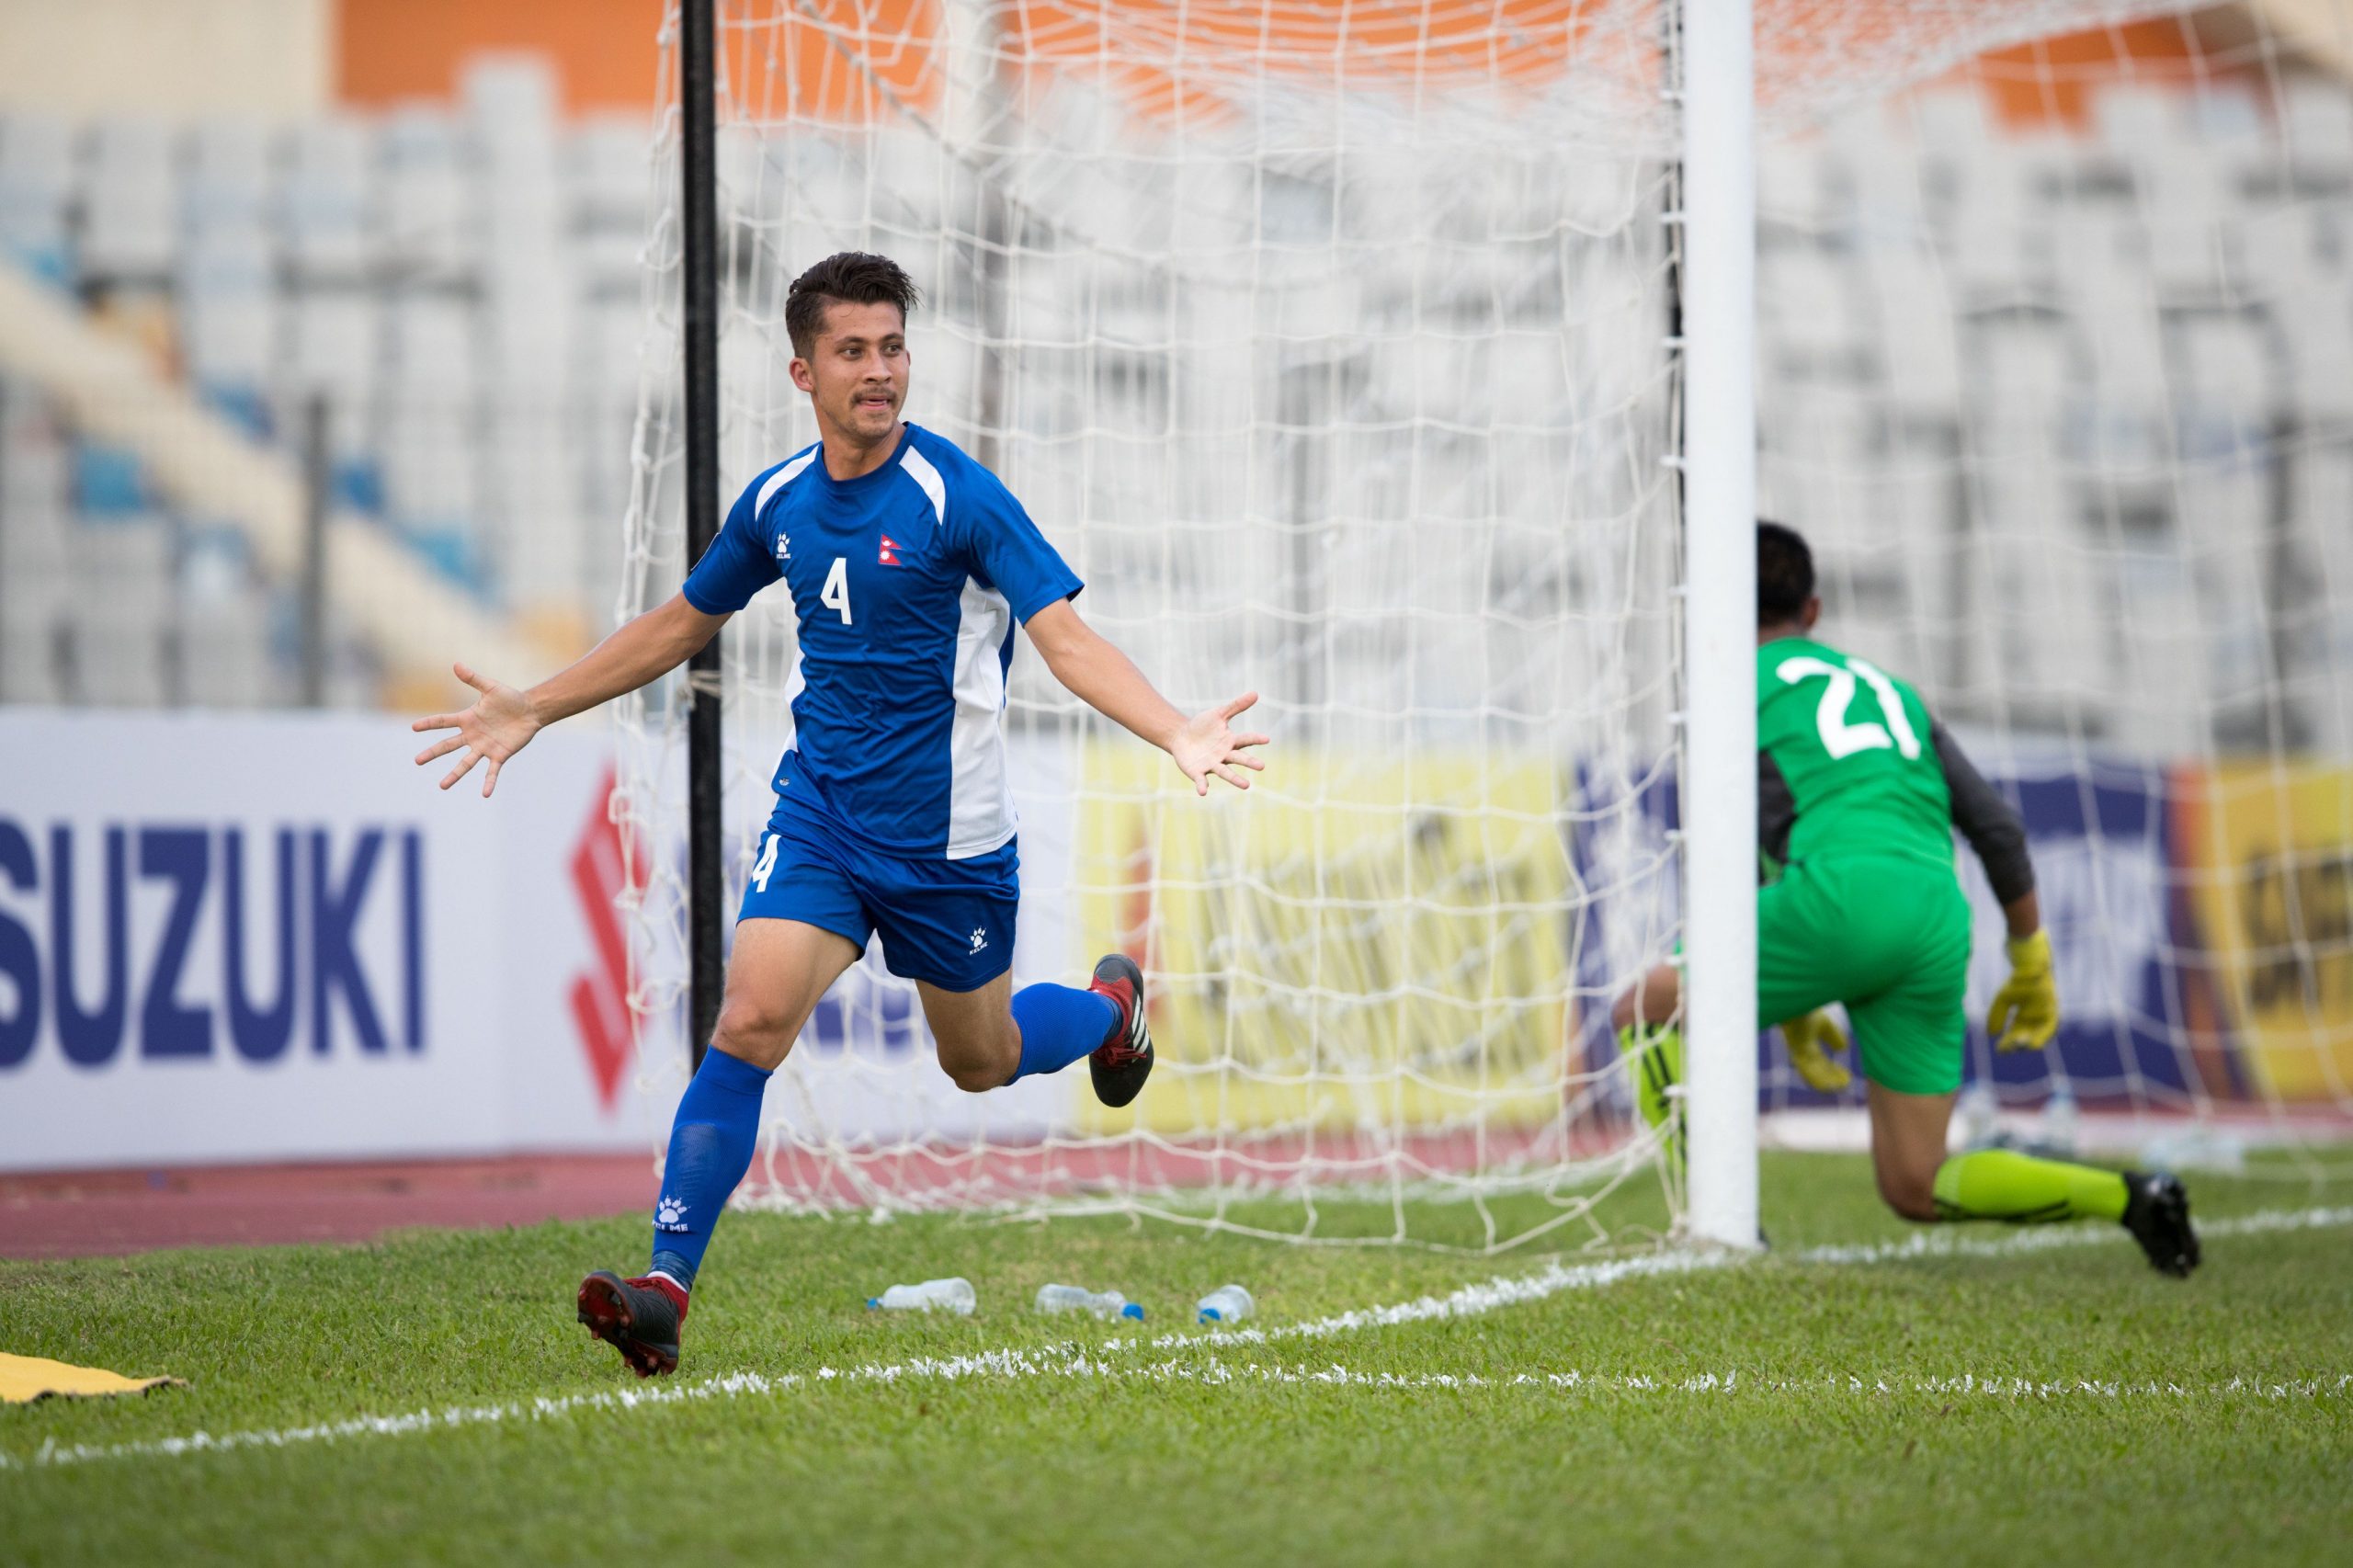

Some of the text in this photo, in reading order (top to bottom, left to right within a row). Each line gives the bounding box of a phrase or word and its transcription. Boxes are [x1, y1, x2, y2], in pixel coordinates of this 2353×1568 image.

[820, 557, 852, 625] 4
[1776, 656, 1921, 761] 21
[752, 834, 781, 893] 4
[0, 816, 426, 1073] SUZUKI
[969, 941, 988, 956] KELME
